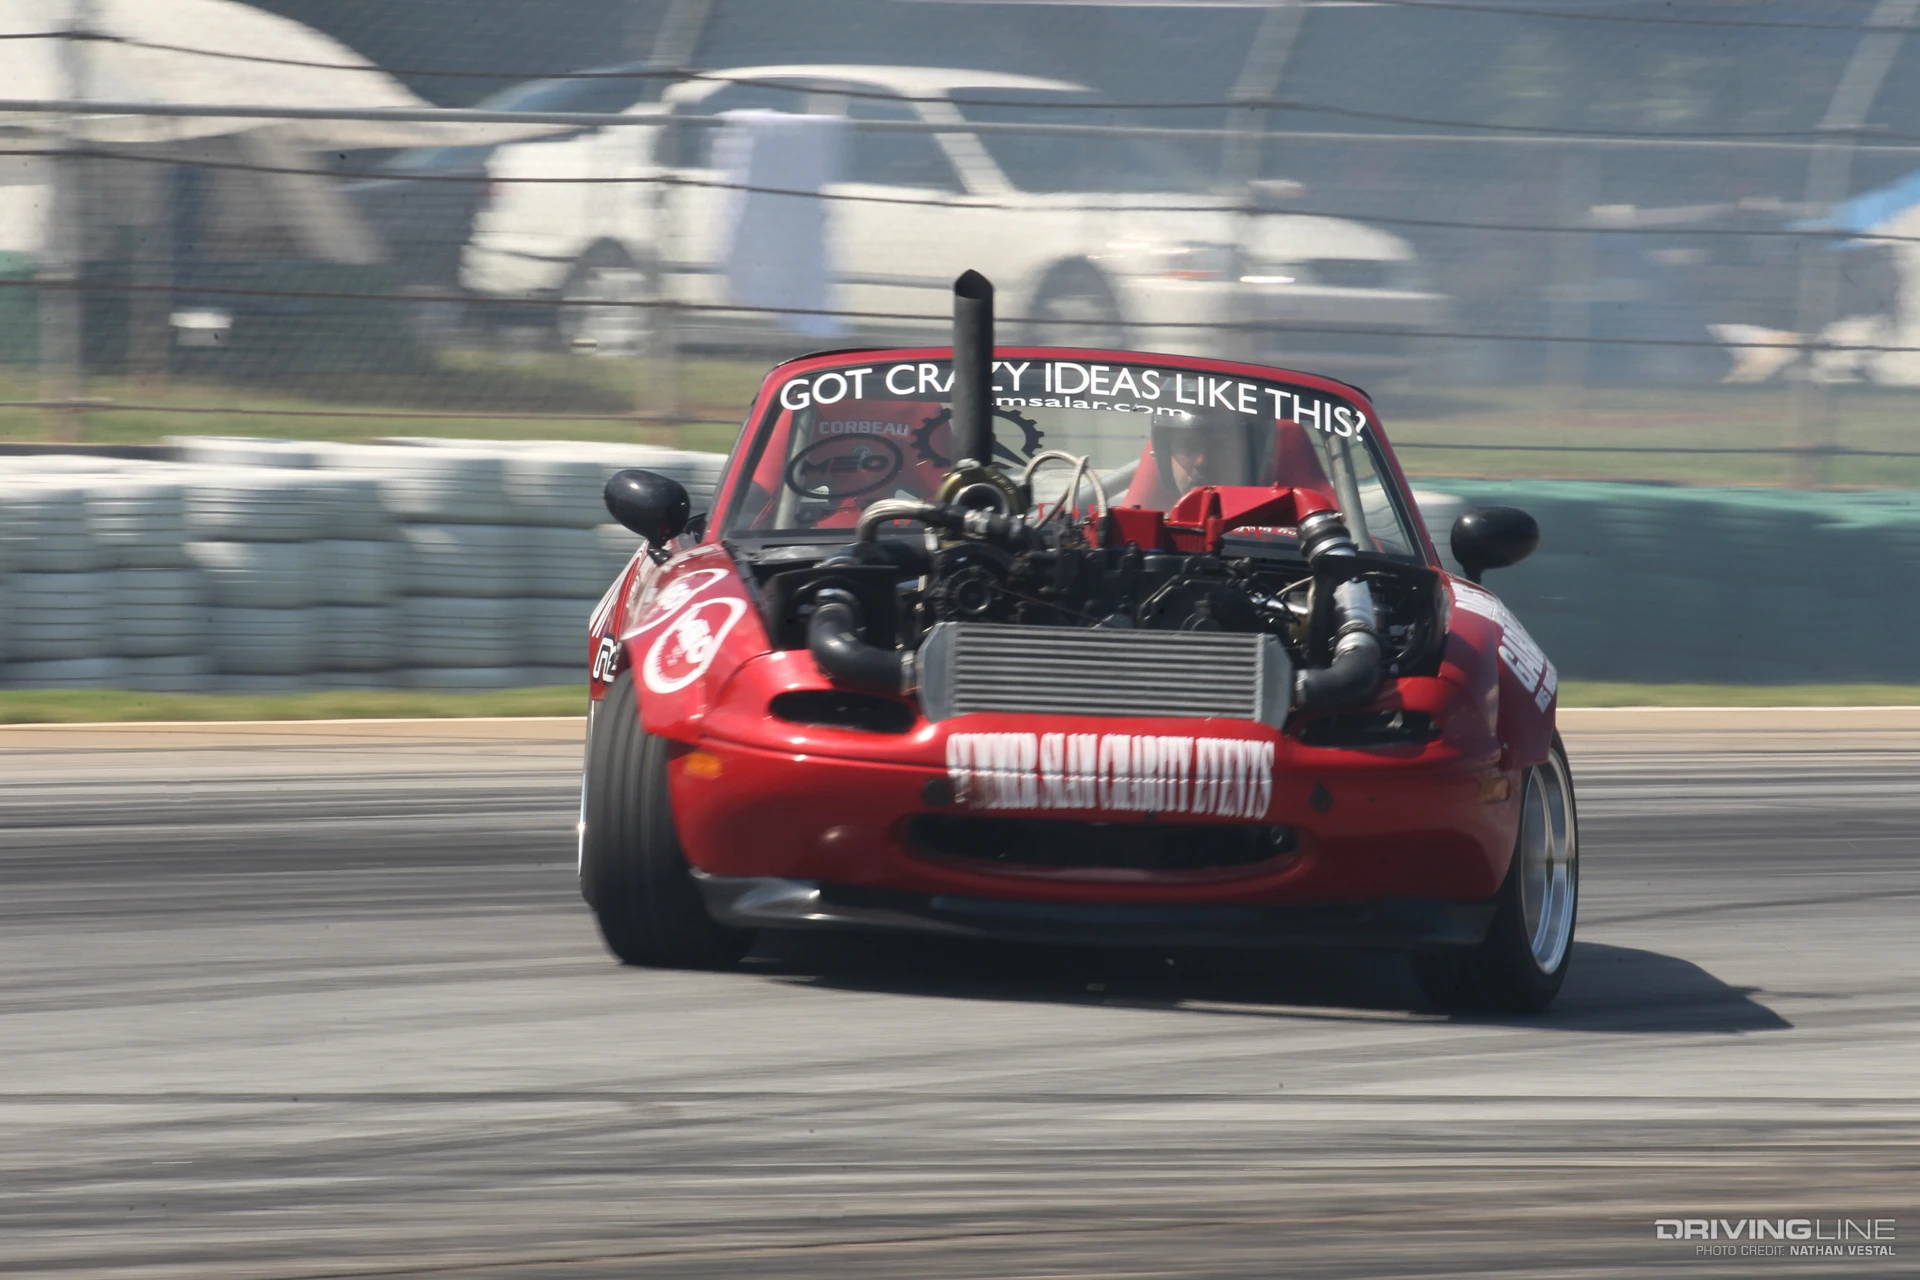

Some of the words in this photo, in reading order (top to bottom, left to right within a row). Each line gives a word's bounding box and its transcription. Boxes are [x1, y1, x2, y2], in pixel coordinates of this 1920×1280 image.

[780, 368, 872, 410] GOT
[1045, 362, 1160, 400] IDEAS
[1176, 373, 1258, 414] LIKE
[1265, 387, 1367, 442] THIS?
[819, 420, 911, 436] CORBEAU
